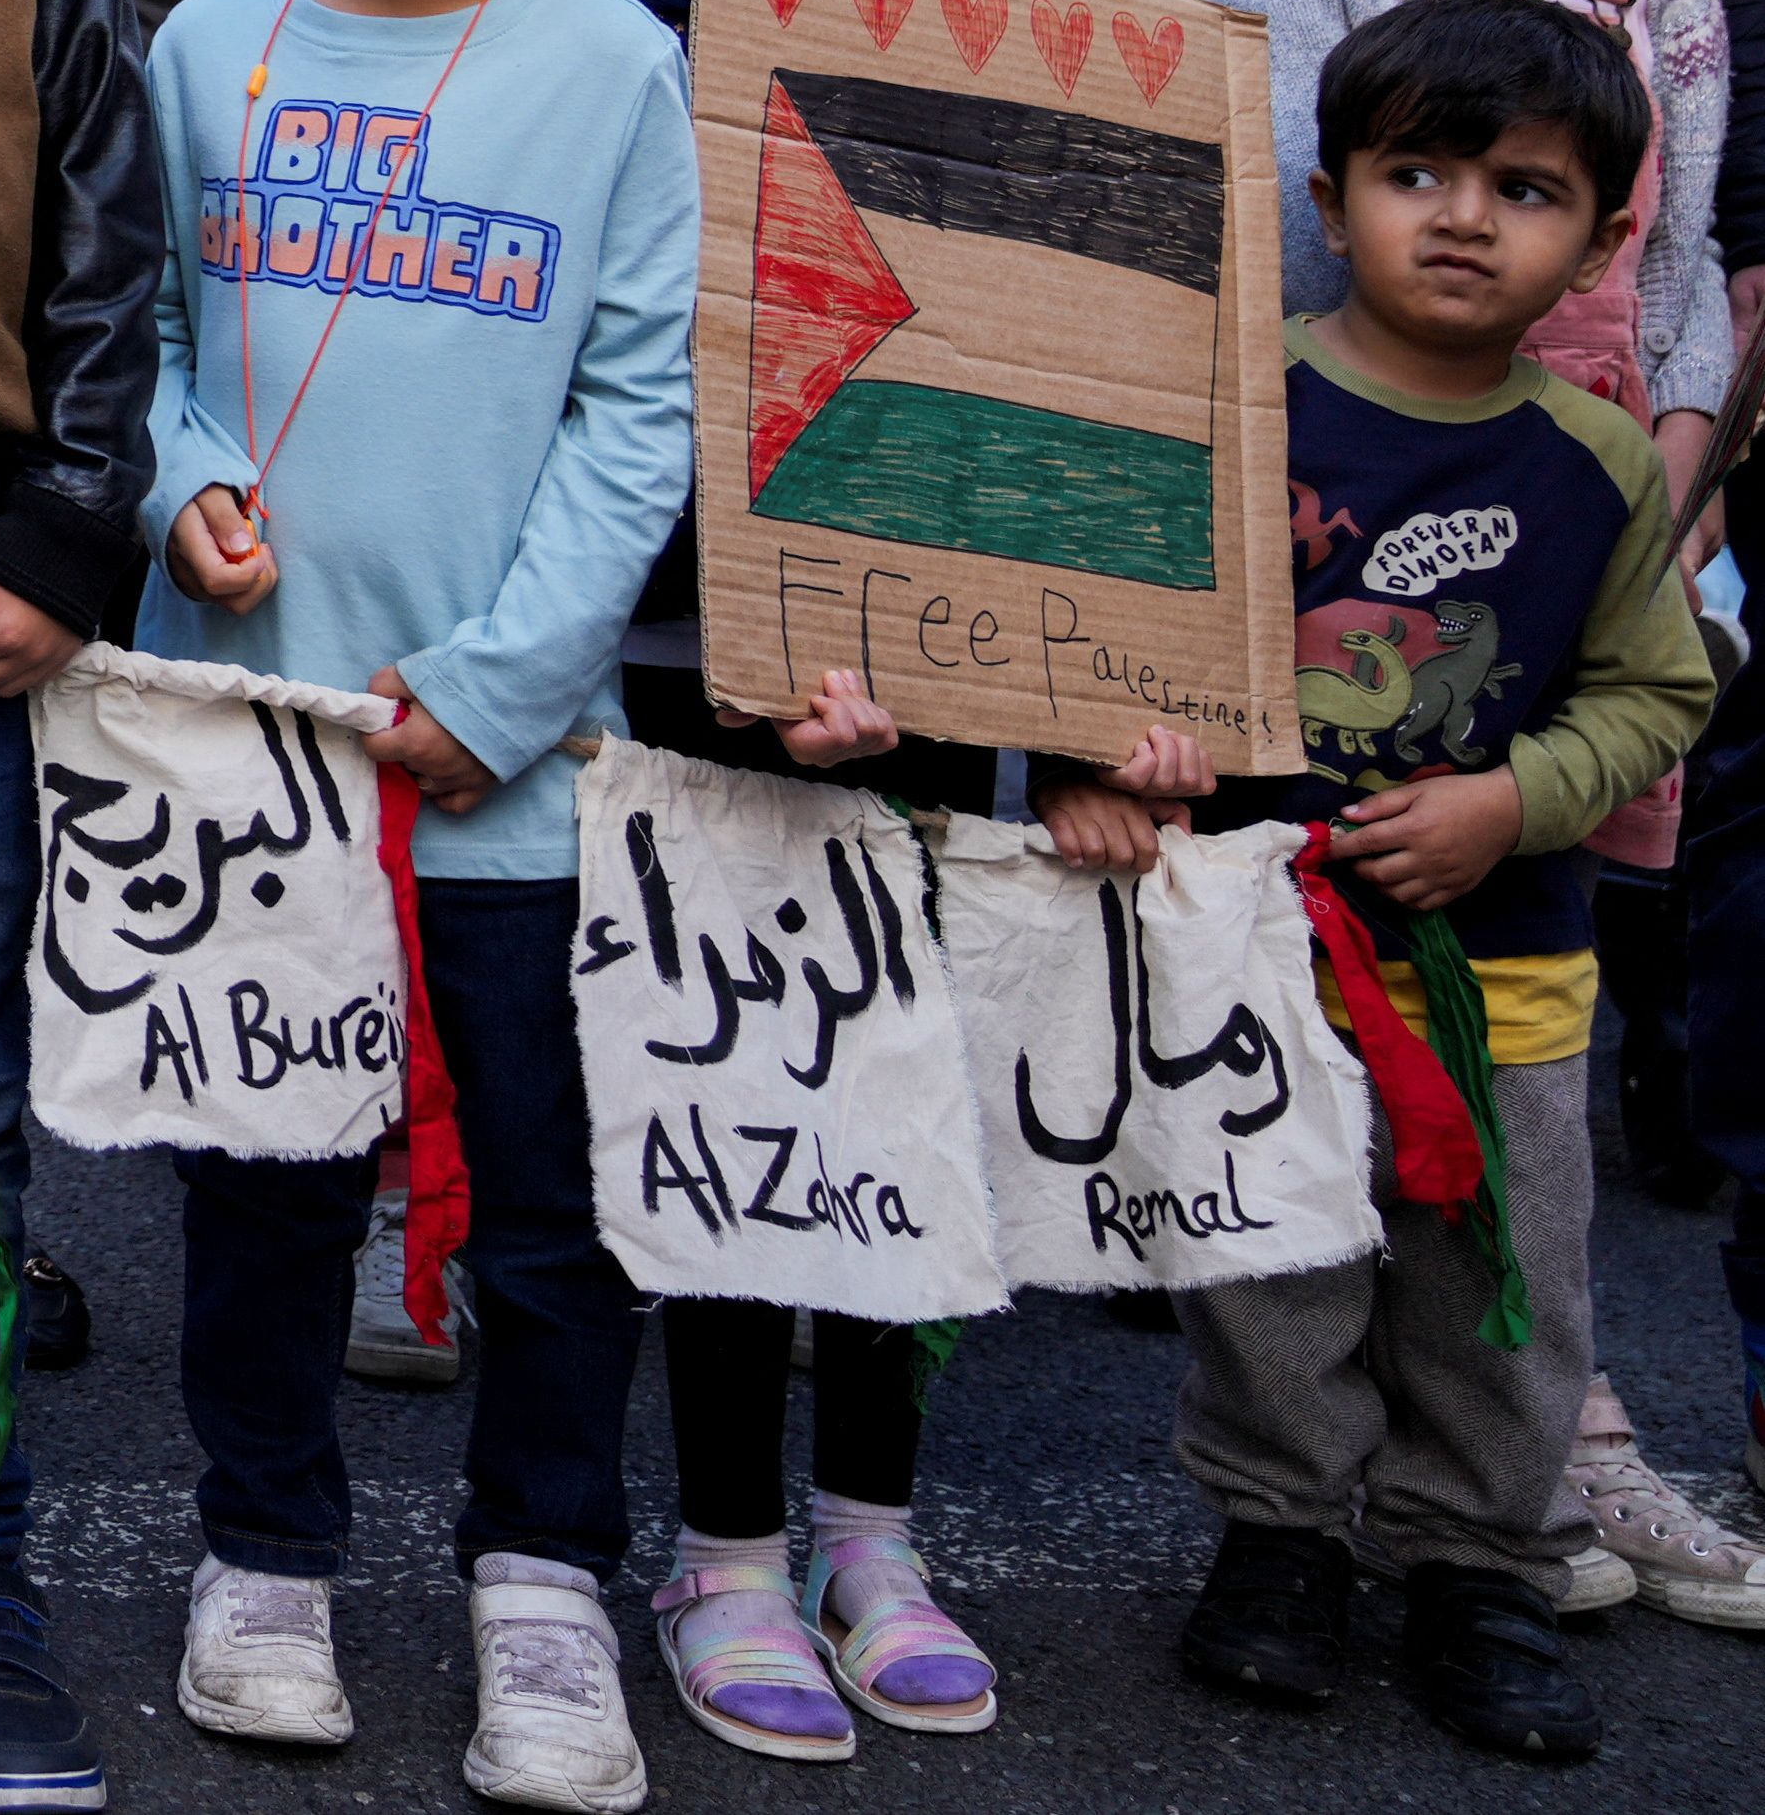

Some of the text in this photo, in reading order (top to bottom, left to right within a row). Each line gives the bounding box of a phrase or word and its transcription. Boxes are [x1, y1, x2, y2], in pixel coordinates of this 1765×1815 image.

[265, 106, 427, 198] BIG
[201, 188, 548, 311] BROTHER
[1376, 516, 1479, 573] FOREVER
[779, 547, 1274, 744] Free Palestine!
[42, 700, 351, 1015] البريج
[574, 810, 917, 1091] الزهراء
[140, 983, 211, 1106] Al
[1084, 1150, 1273, 1261] Remal
